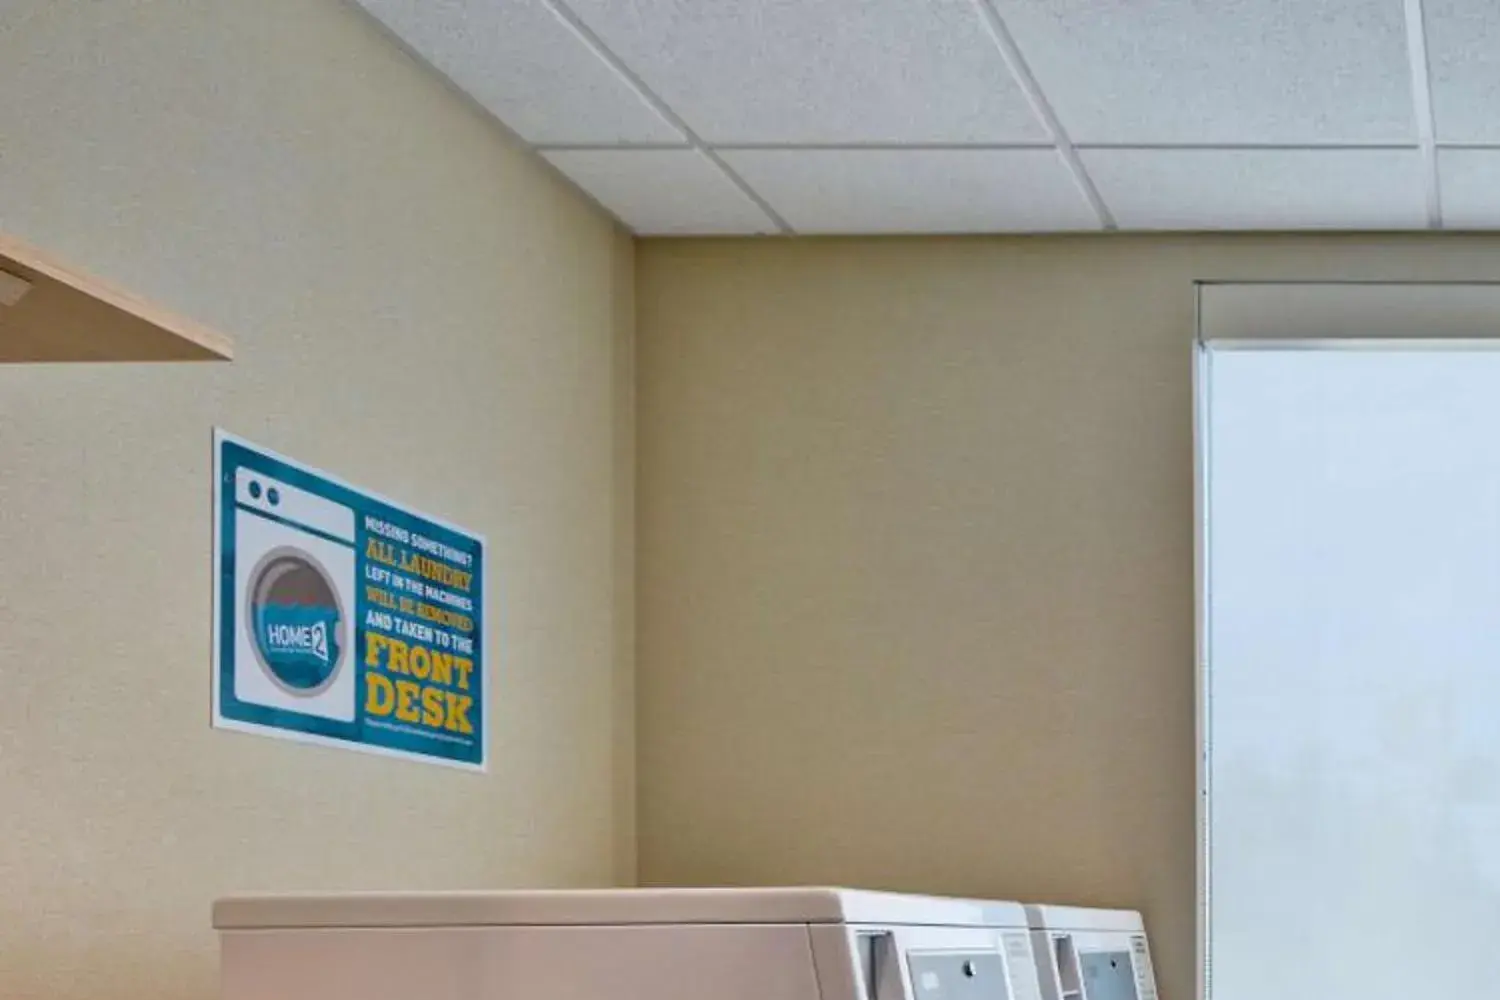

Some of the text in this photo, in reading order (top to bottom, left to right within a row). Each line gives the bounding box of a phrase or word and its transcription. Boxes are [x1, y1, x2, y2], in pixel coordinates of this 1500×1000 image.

[365, 515, 409, 544] MISSING
[365, 562, 390, 585] LEFT
[391, 571, 404, 589] IN
[405, 577, 424, 596] THE
[366, 536, 472, 593] ALL LAUNDRY
[366, 585, 395, 609] WILL
[398, 595, 414, 614] BE
[366, 608, 472, 655] AND TAKEN TO THE
[365, 631, 473, 690] FRONT
[365, 672, 473, 734] DESK
